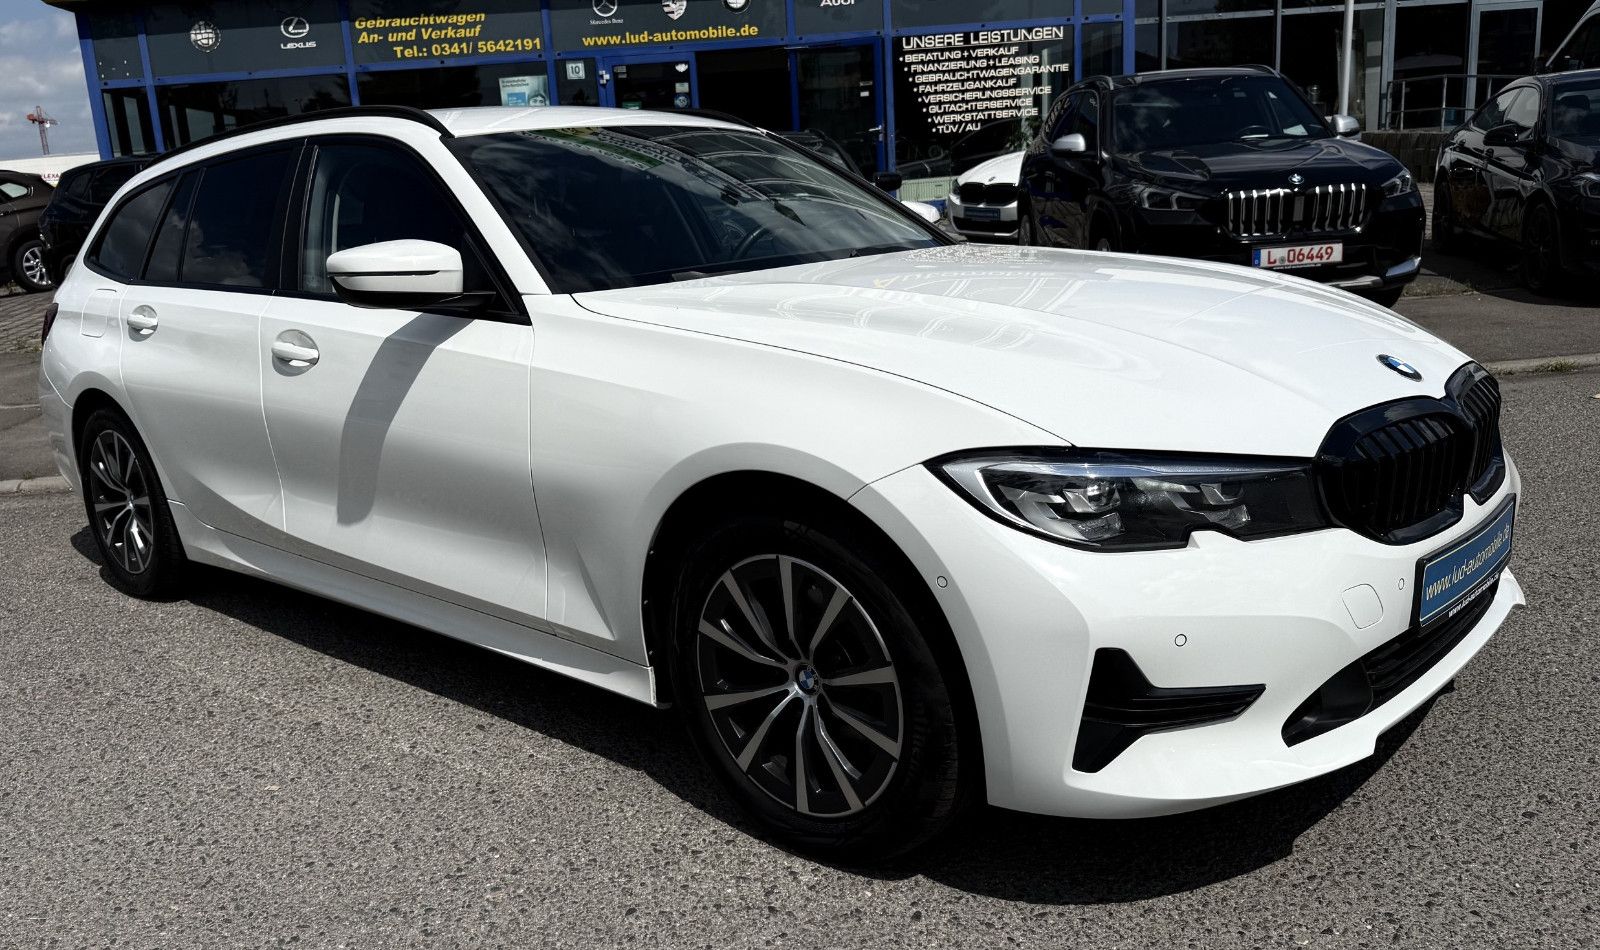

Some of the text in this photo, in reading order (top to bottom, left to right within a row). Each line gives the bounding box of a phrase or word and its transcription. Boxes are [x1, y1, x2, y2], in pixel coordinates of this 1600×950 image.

[355, 13, 486, 29] Gebrauchtwagen
[358, 25, 482, 43] An- und Verkauf
[582, 24, 759, 47] www.lud-automobile.de
[902, 26, 1064, 49] UNSERE LEISTUNGEN
[280, 41, 316, 49] LEXUS
[393, 38, 541, 58] Tel.: 0341/ 5642191
[571, 65, 580, 75] 10
[915, 63, 1069, 83] GEBRAUCHTWAGENGARANTIE
[919, 78, 1017, 93] FAHRZEUGANKAUF
[922, 86, 1052, 103] VERSICHERUNGSSERVICE
[928, 98, 1033, 114] GUTACHTERSERVICE
[932, 108, 1038, 124] WERKSTATTSERVICE
[1267, 250, 1276, 265] L
[1286, 246, 1334, 263] 06449
[1426, 523, 1510, 600] www.lud-automobile.de
